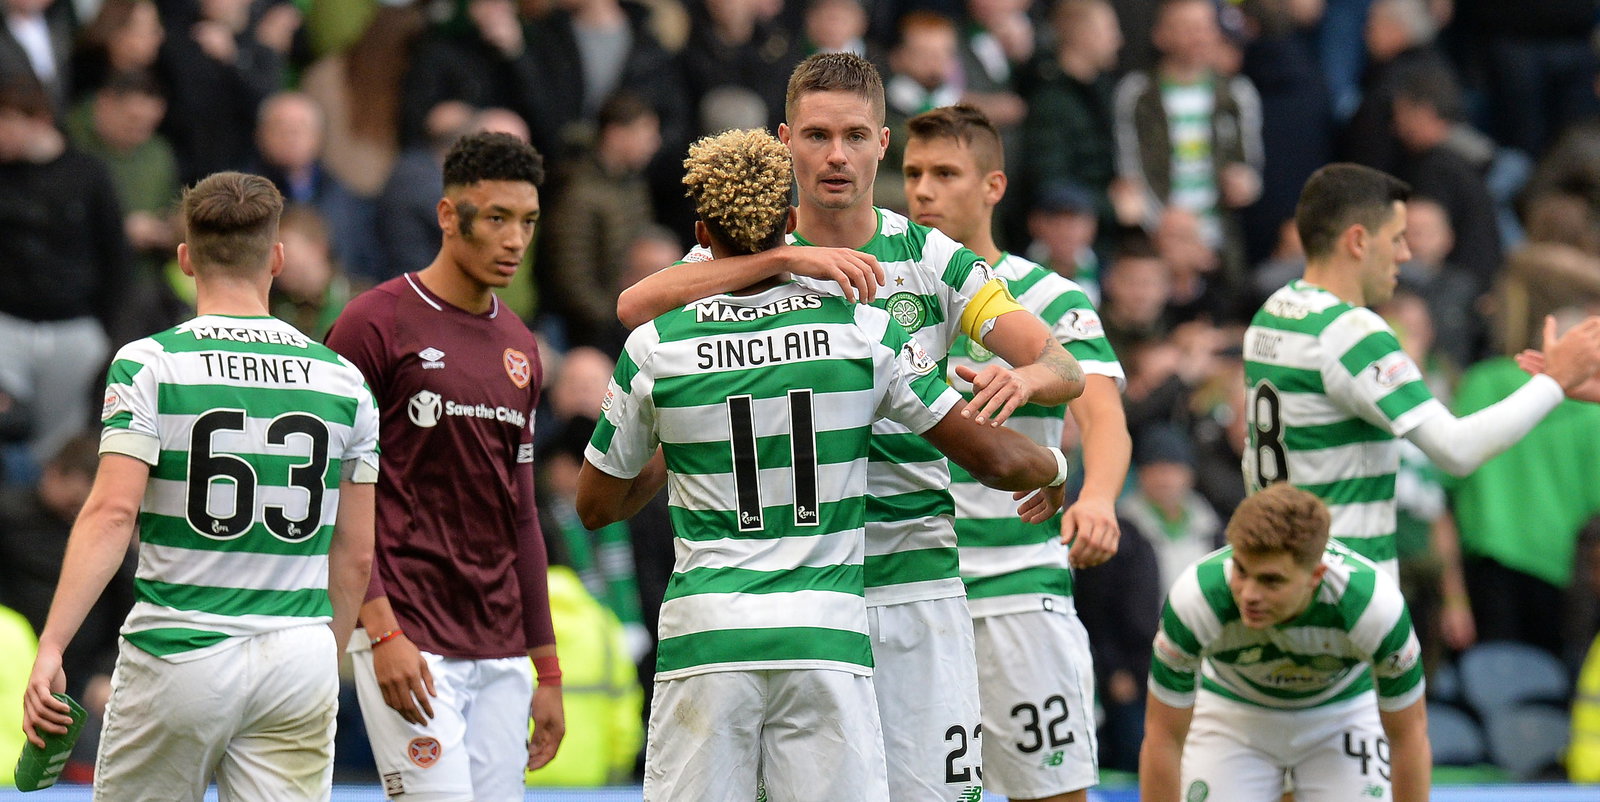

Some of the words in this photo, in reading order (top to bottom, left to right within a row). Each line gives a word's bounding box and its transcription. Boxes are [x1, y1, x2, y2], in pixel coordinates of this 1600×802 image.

[695, 294, 823, 323] MAGNERS
[190, 326, 310, 348] MAGNERS
[697, 329, 830, 369] SINCLAIR
[200, 353, 311, 383] TIERNEY
[445, 400, 475, 416] Save
[475, 403, 495, 419] the
[185, 408, 330, 543] 63
[727, 388, 819, 532] 11
[1011, 695, 1075, 753] 32
